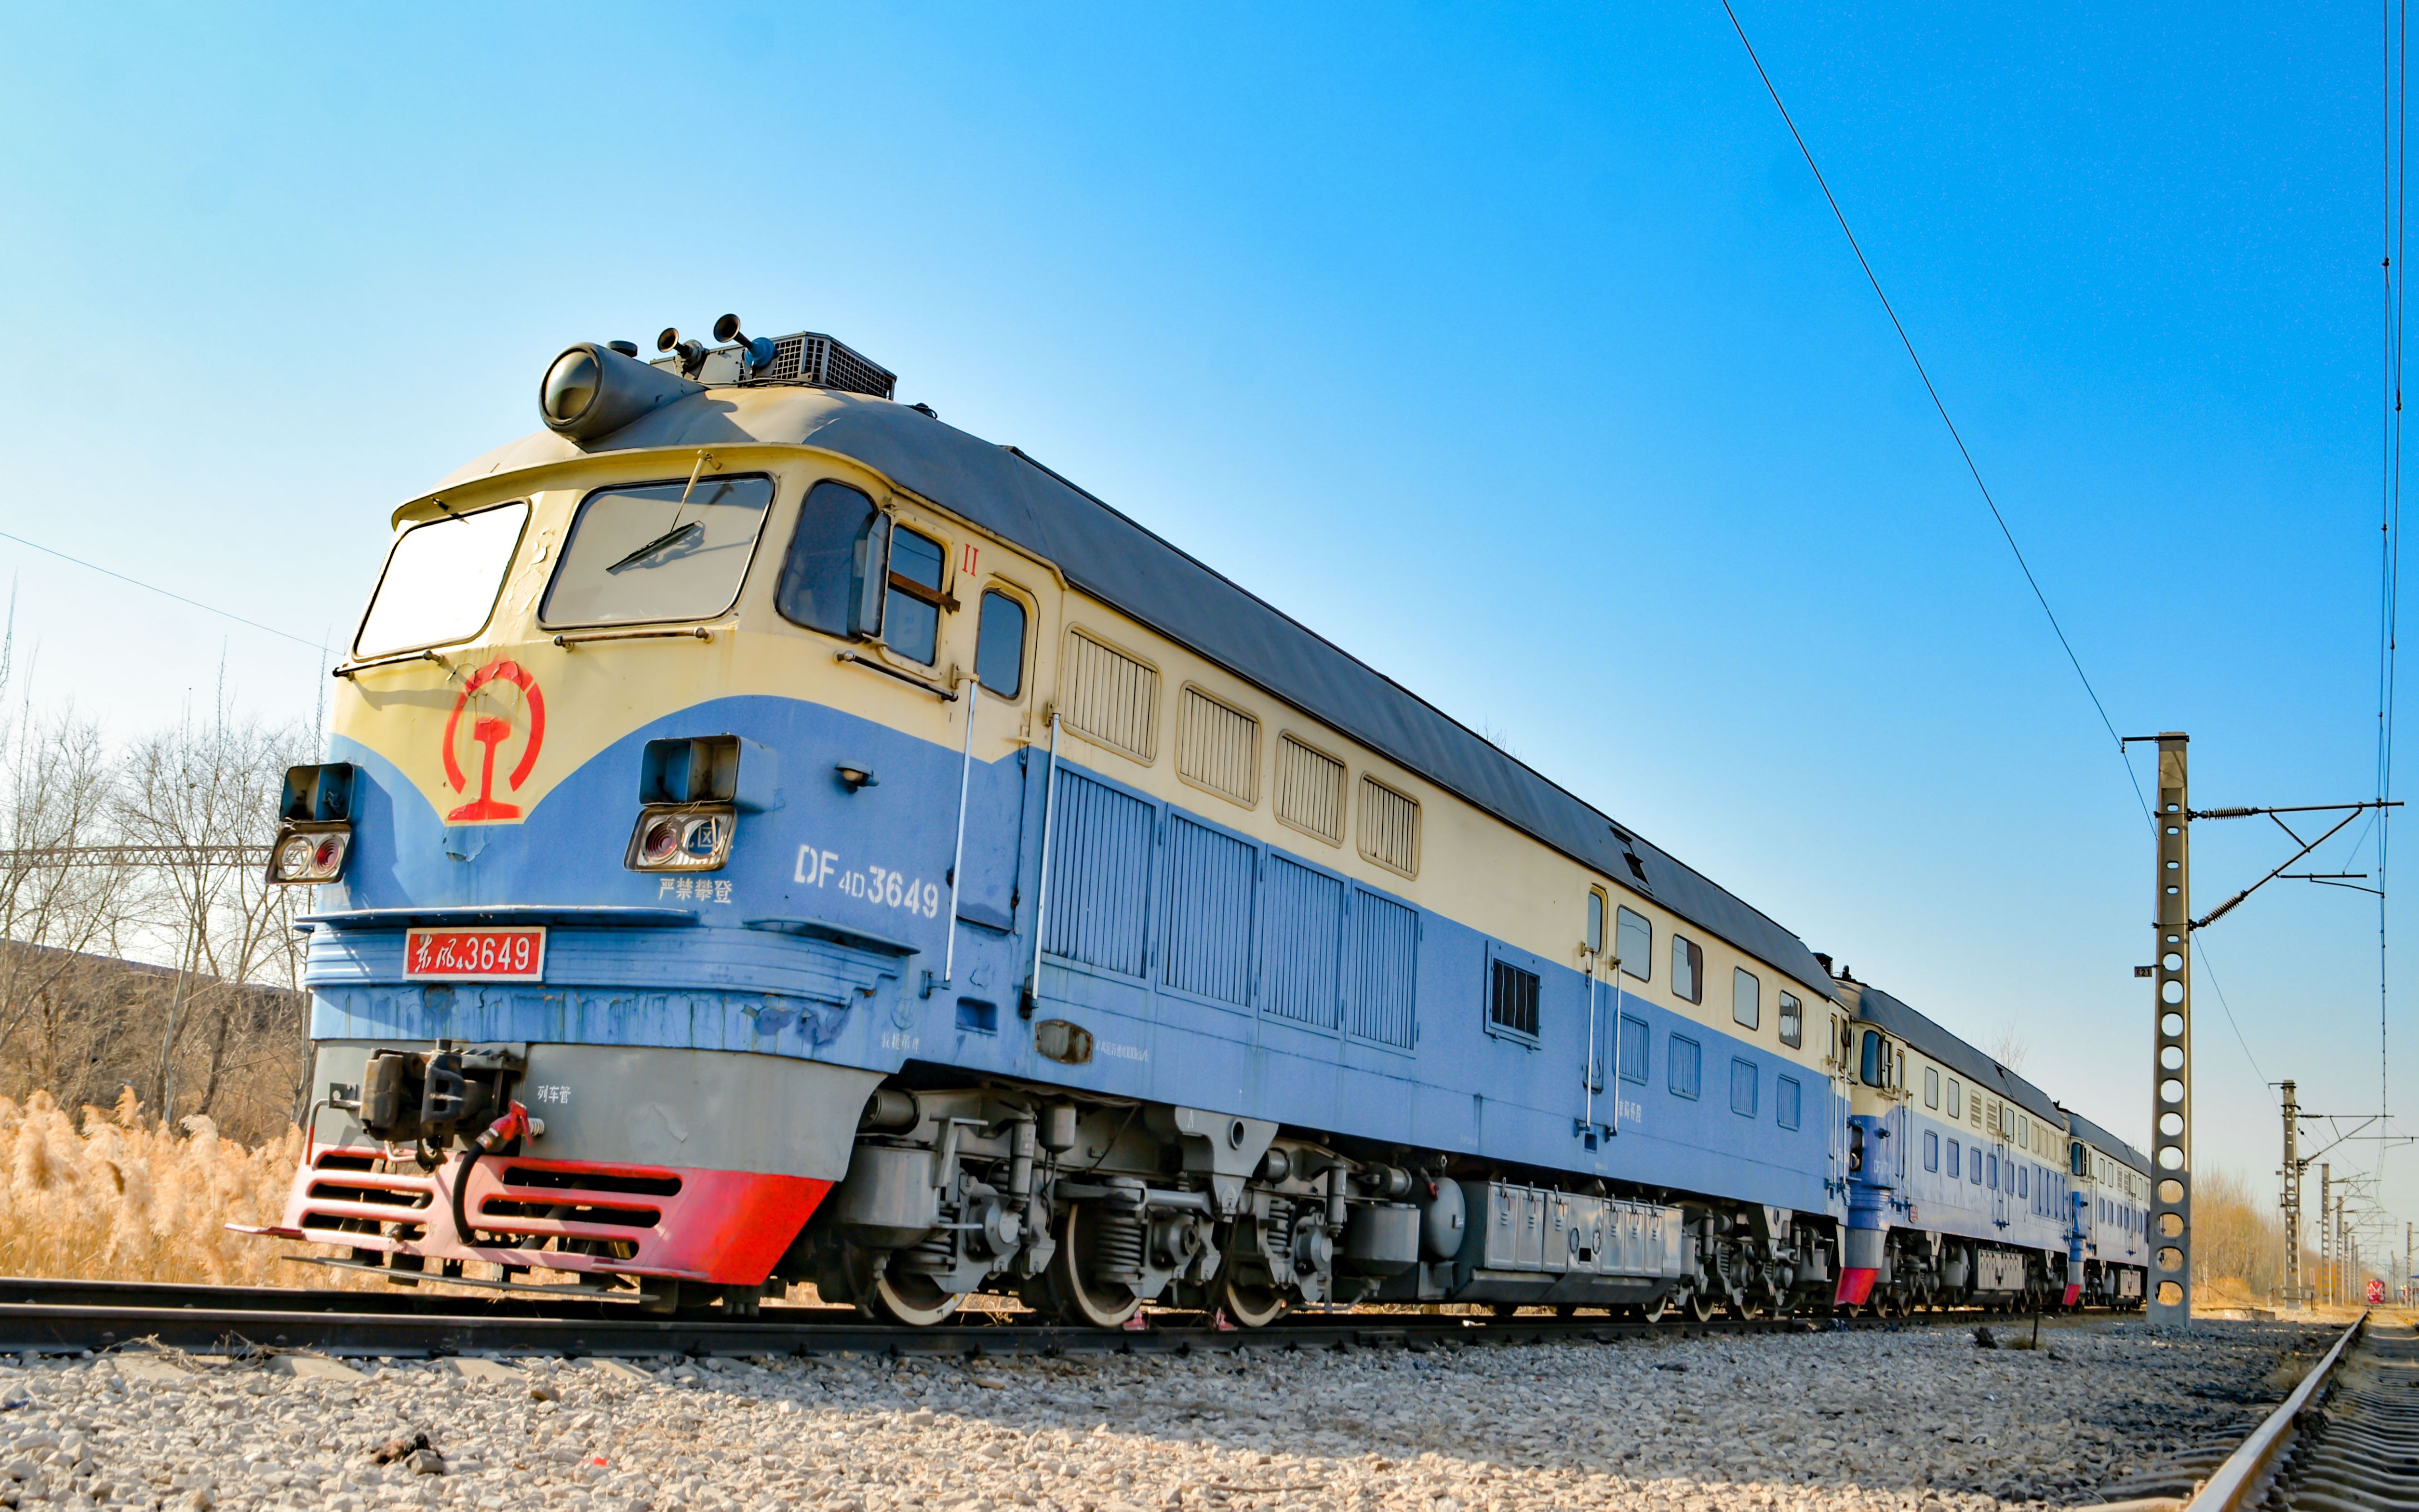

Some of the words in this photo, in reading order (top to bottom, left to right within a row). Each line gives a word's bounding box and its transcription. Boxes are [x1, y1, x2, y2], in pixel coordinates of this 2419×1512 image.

[658, 877, 732, 903] 严禁攀登
[537, 1085, 571, 1104] 列车管
